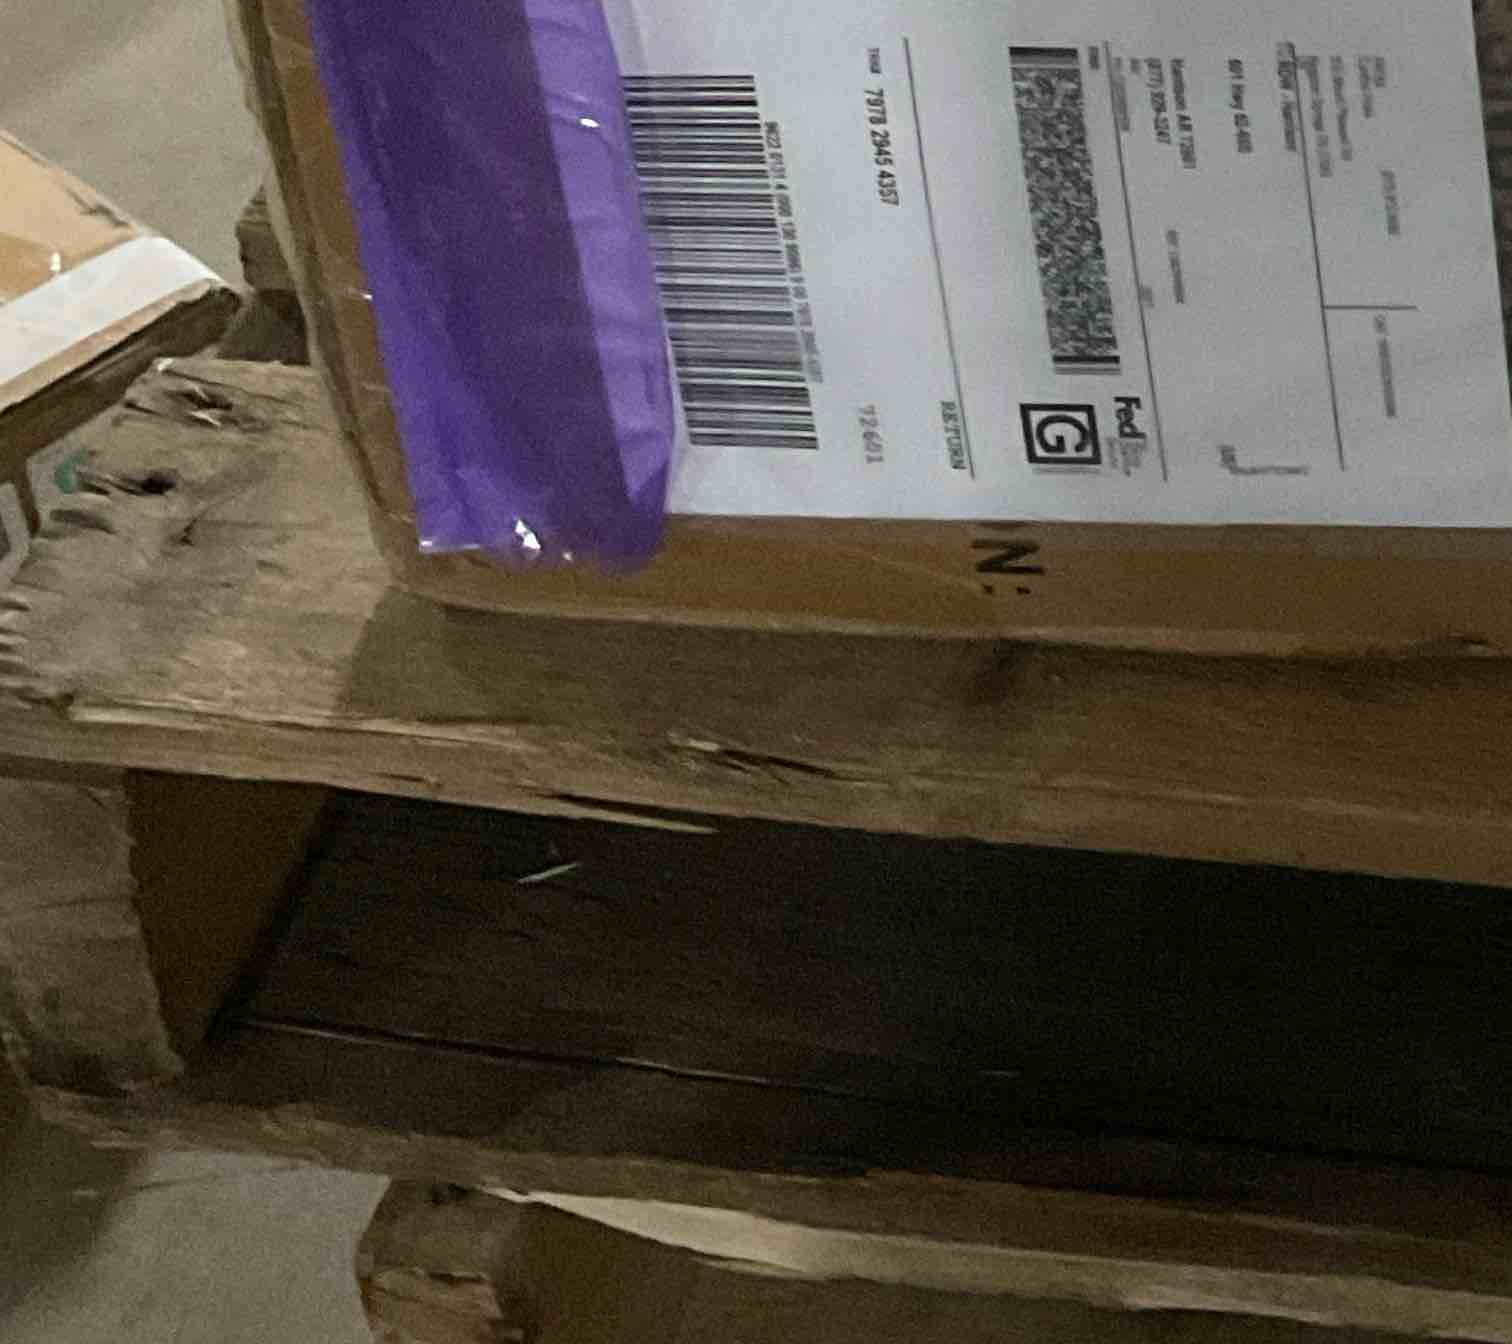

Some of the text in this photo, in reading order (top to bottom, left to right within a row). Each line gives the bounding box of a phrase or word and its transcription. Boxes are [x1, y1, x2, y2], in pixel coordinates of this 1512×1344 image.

[863, 87, 892, 126] 7978
[870, 129, 896, 165] 2945
[874, 169, 901, 208] 4357
[857, 402, 885, 465] 72601
[938, 398, 969, 471] RETURN
[1036, 413, 1089, 455] G
